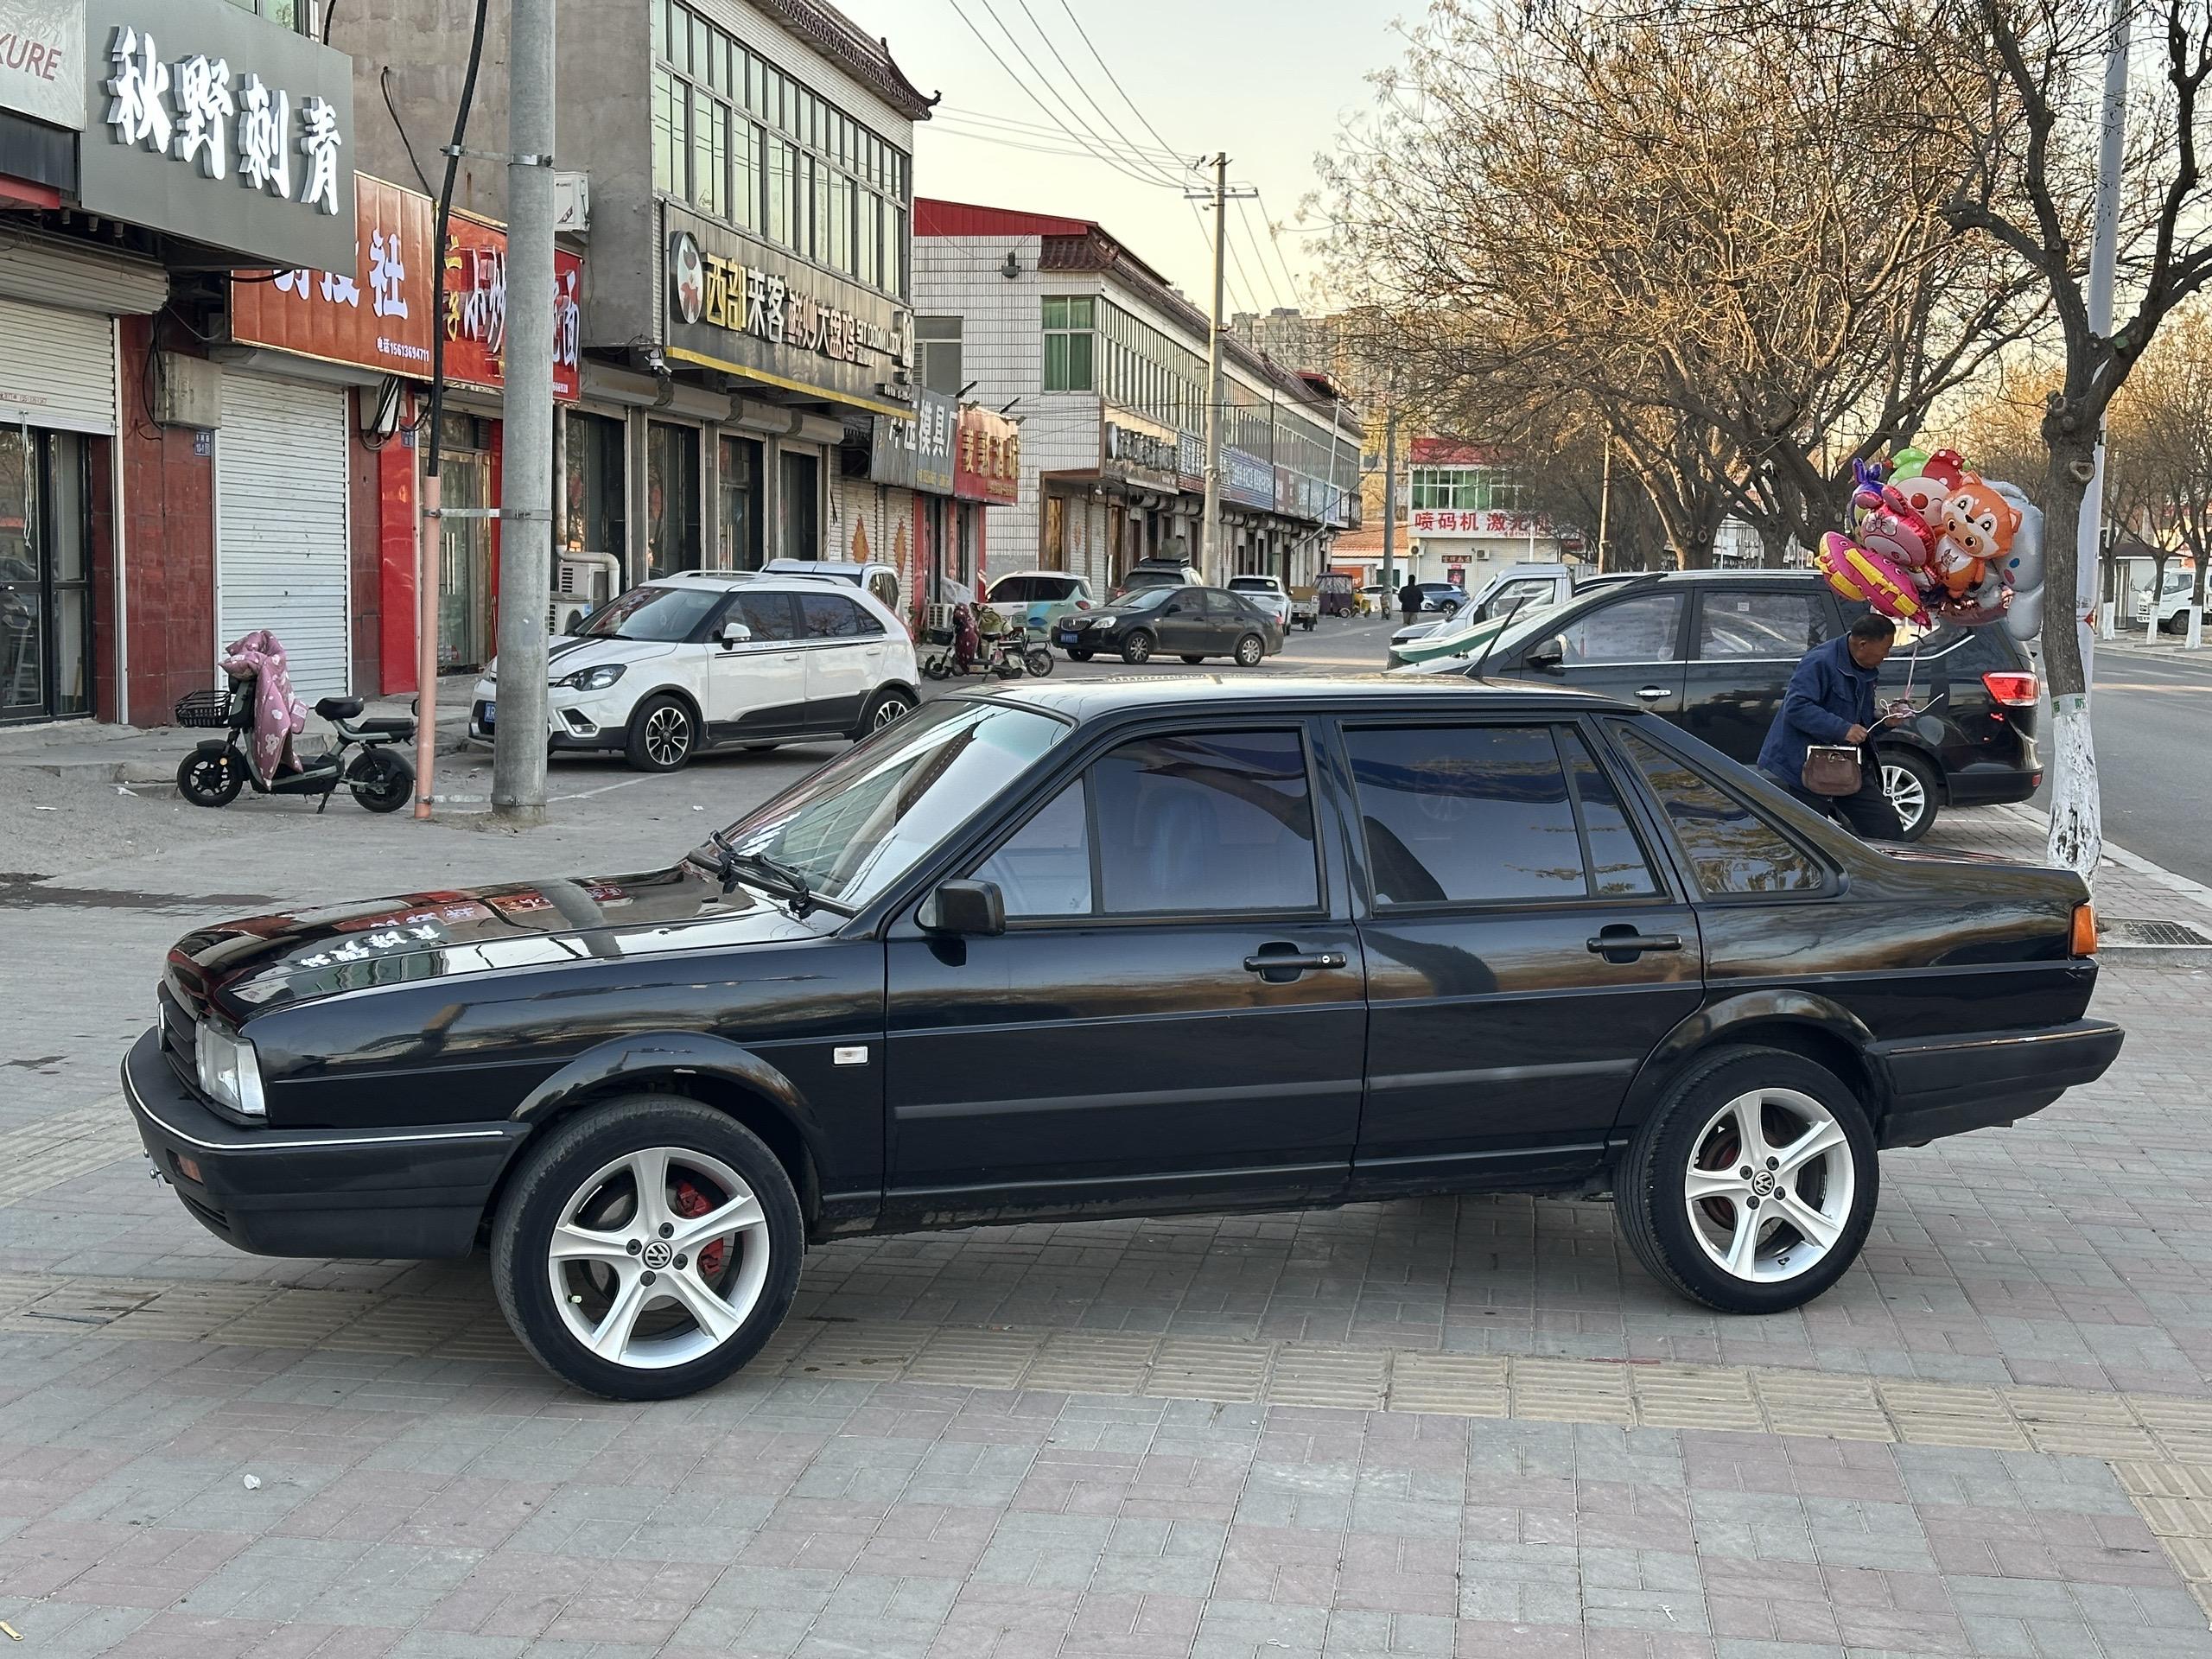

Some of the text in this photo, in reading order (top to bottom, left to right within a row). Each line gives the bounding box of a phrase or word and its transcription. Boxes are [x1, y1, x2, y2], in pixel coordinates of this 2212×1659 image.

[107, 25, 342, 216] 秋野刺青
[706, 251, 785, 345] 西部来客
[1414, 512, 1479, 531] 喷码机
